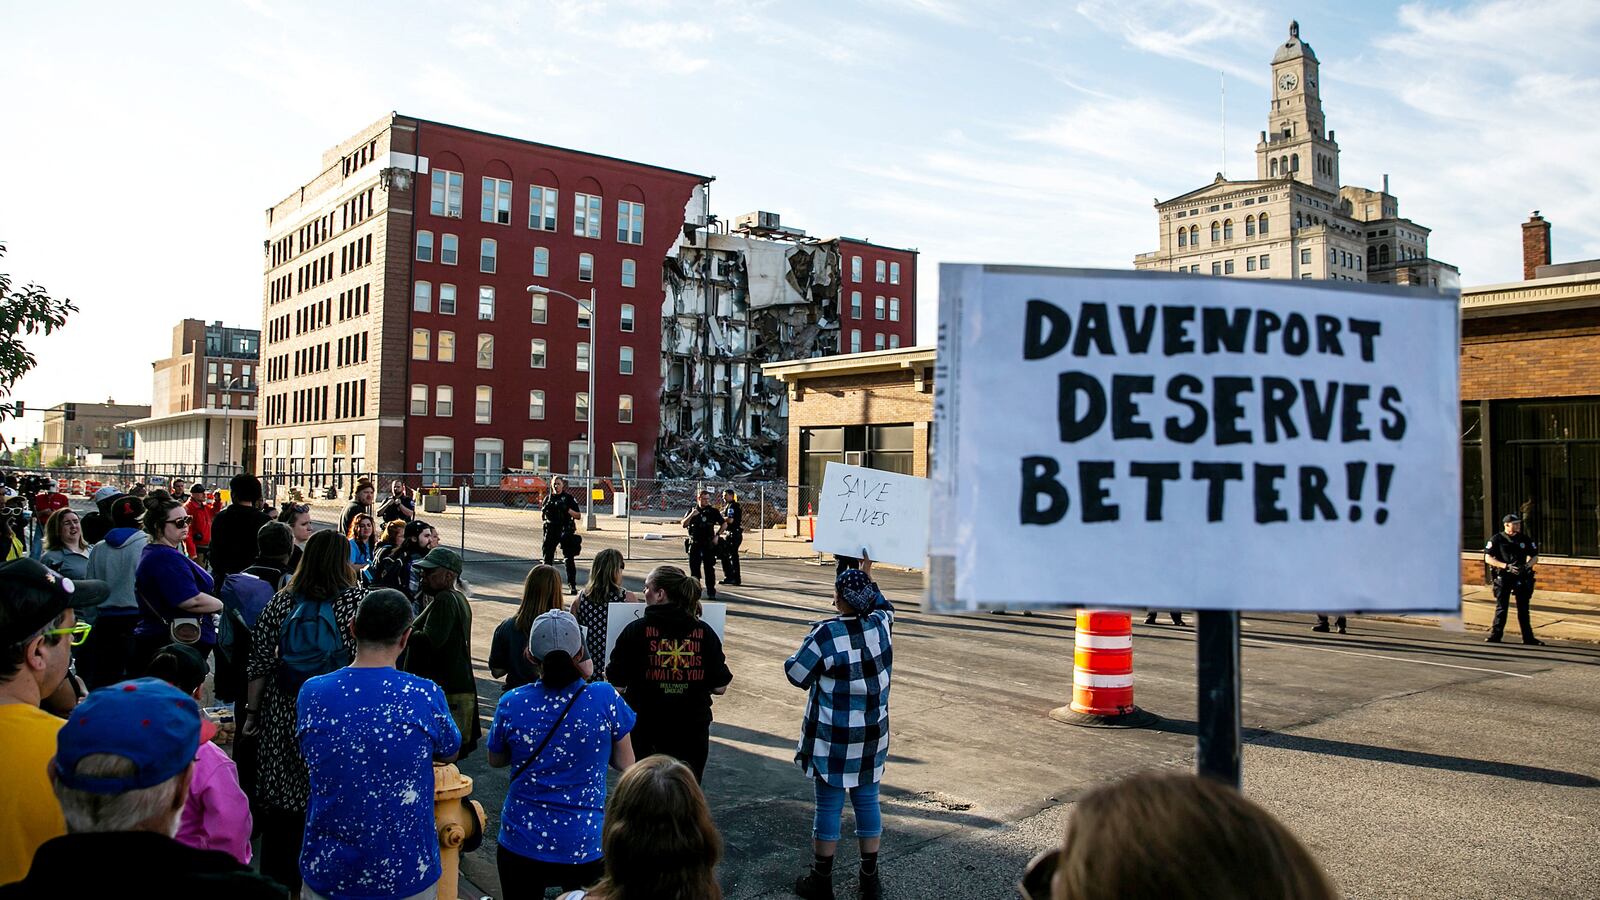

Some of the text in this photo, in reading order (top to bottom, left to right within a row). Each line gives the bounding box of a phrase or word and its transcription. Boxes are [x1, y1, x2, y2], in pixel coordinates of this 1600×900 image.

[1023, 299, 1381, 362] DAVENPORT
[1058, 371, 1407, 444] DESERVES
[837, 474, 893, 502] SAVE
[1019, 455, 1395, 526] BETTER!!
[840, 503, 890, 527] LIVES
[687, 669, 704, 680] YOU
